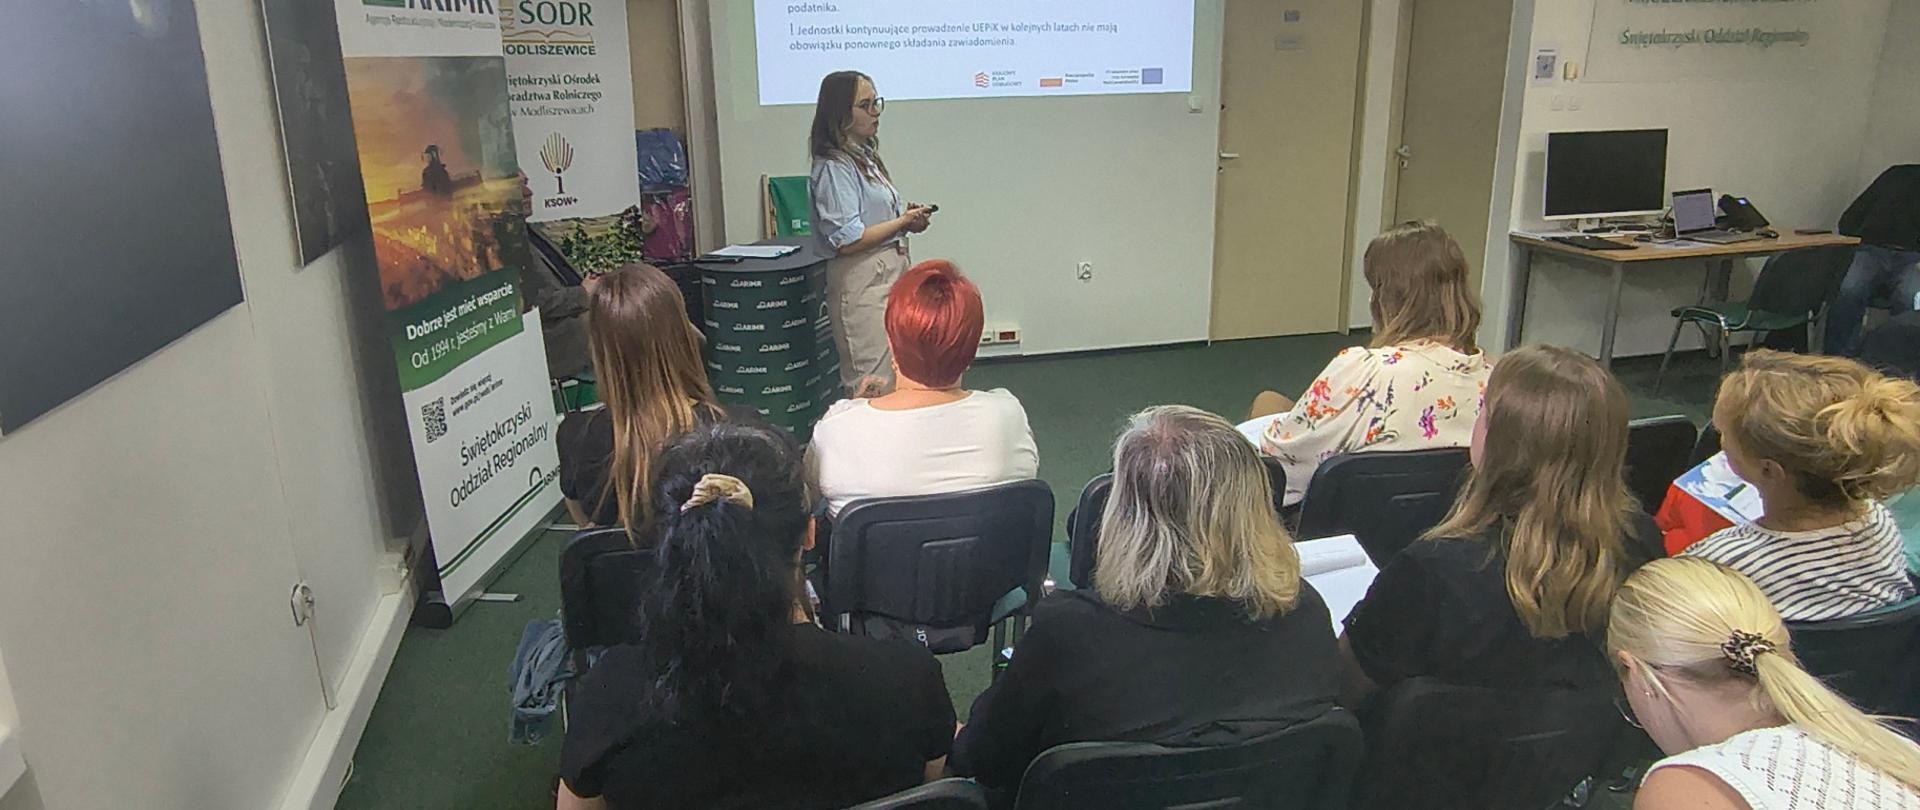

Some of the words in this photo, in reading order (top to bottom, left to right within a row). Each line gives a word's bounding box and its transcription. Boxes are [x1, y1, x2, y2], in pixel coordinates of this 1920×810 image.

[787, 3, 840, 14] podatnika.
[797, 25, 843, 35] Jednostki
[846, 24, 909, 36] kontynuujące
[912, 23, 970, 34] prowadzenie
[1001, 24, 1009, 32] w
[1010, 22, 1052, 34] kolejnych
[1053, 22, 1080, 32] latach
[1081, 22, 1094, 32] nie
[1096, 22, 1118, 33] mają
[789, 40, 842, 51] obowiązku
[844, 39, 901, 50] ponownego
[508, 73, 561, 88] iętokrzyski
[563, 72, 601, 85] Ośrodek
[507, 90, 551, 101] radztwa
[553, 89, 602, 102] Rolniczego
[406, 316, 442, 340] Dobrze
[443, 306, 458, 328] jest
[458, 295, 476, 316] mieć
[477, 282, 513, 306] wsparcie
[411, 348, 429, 368] Od
[431, 338, 449, 361] 1994
[456, 321, 487, 350] jesteśmy
[488, 318, 494, 329] z
[461, 401, 532, 466] Świętokrzyski
[450, 460, 493, 507] Oddział
[493, 421, 548, 473] Regionalny
